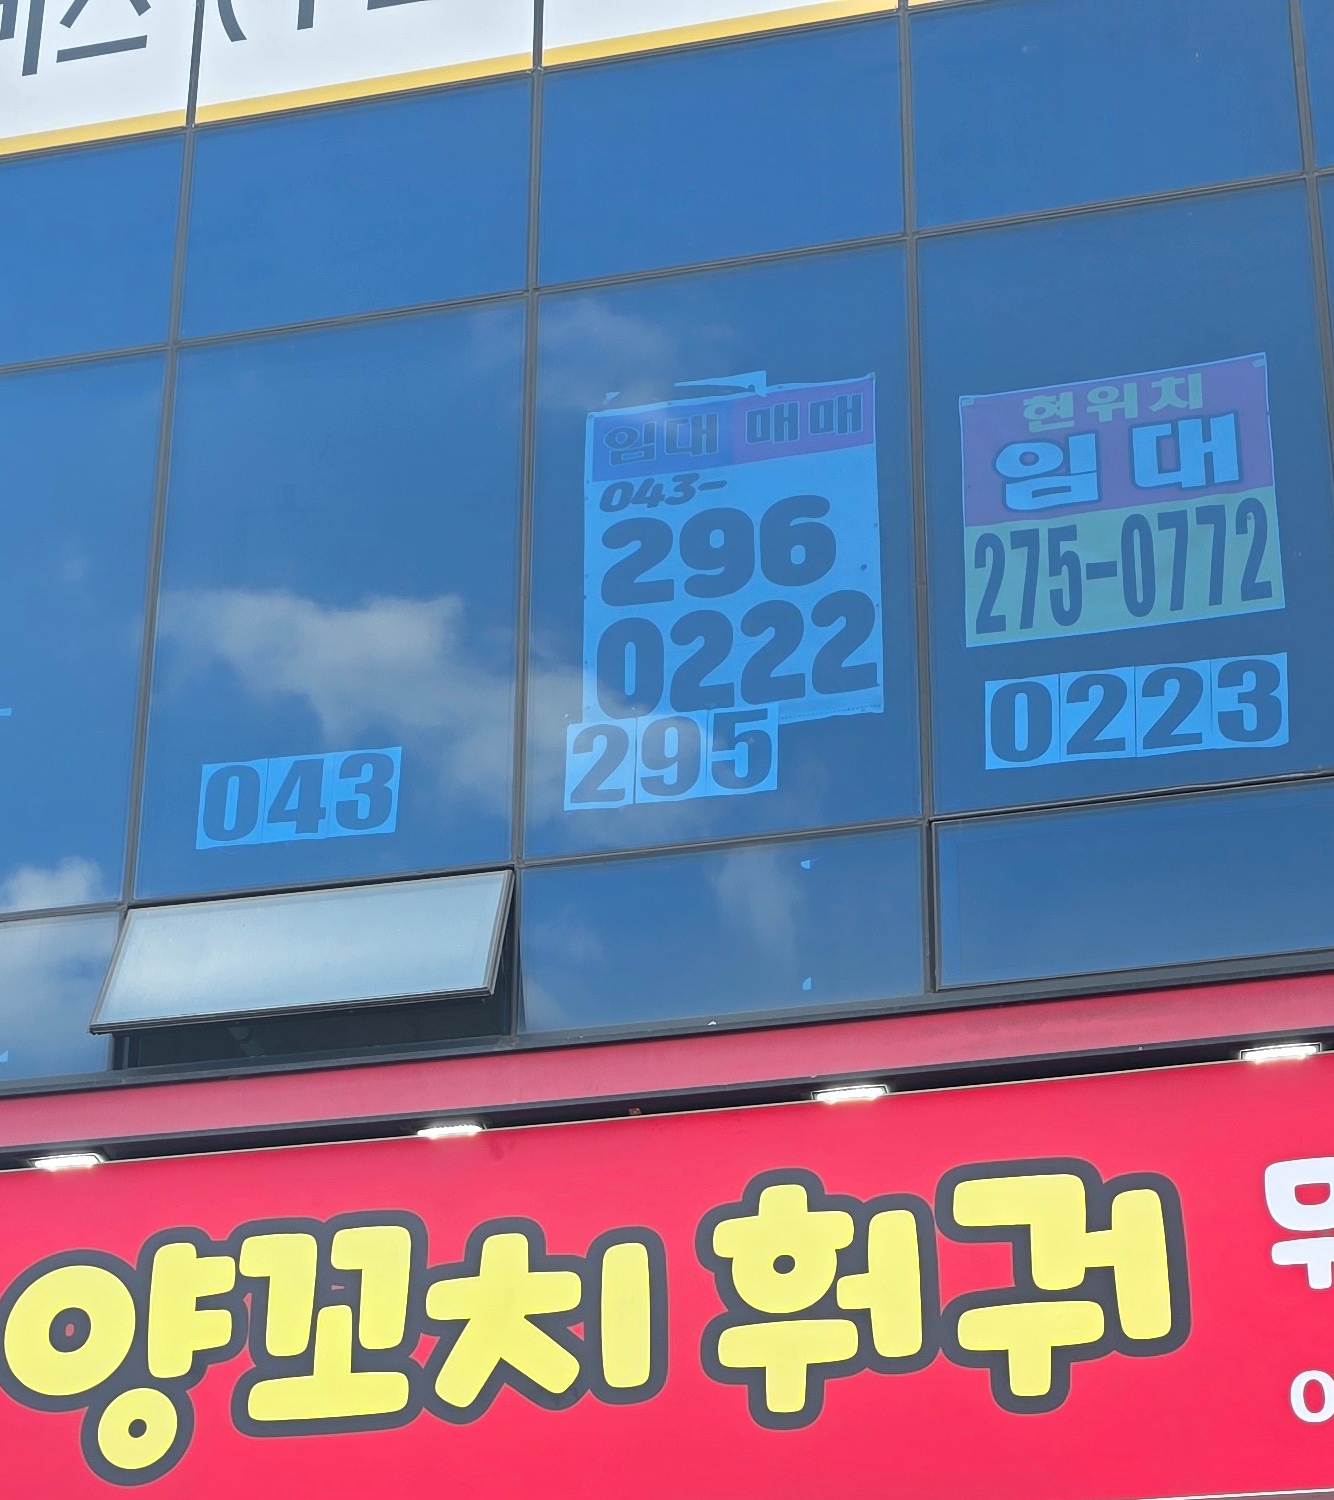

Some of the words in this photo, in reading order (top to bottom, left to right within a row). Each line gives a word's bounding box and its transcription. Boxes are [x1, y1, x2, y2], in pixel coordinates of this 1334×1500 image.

[604, 413, 719, 466] 임대
[745, 393, 863, 444] 매매
[1023, 373, 1203, 433] 현위치
[599, 473, 727, 512] 043-
[994, 412, 1241, 512] 임대
[600, 494, 836, 607] 296
[974, 497, 1273, 634] 275-0772
[597, 590, 878, 720] 0222
[570, 708, 773, 804] 295
[990, 659, 1282, 763] 0223
[203, 753, 395, 841] 043
[702, 1164, 1185, 1422] 훠궈
